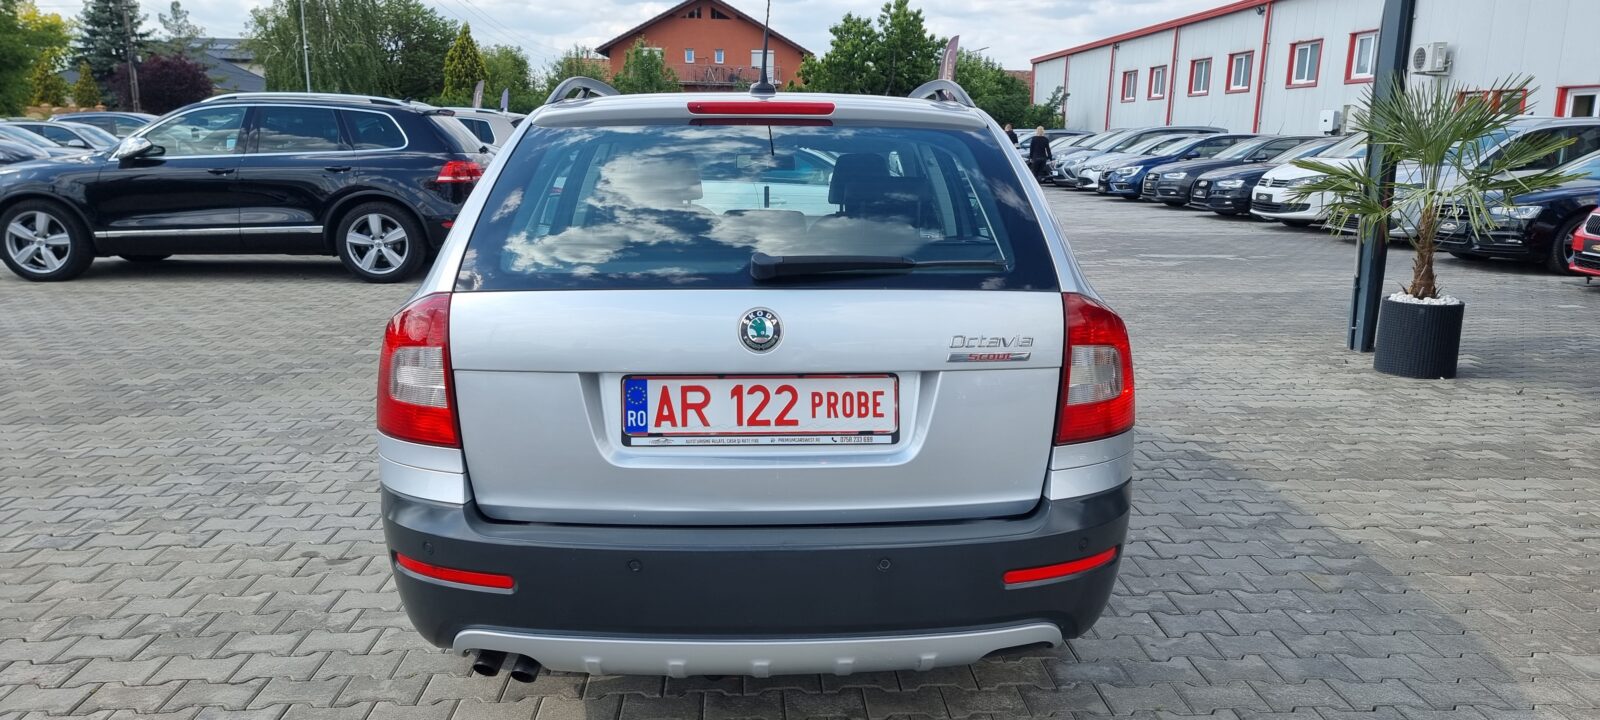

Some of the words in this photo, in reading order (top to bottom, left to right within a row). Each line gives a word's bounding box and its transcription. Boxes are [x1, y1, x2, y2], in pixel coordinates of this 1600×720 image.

[949, 333, 1034, 349] Octavia
[653, 384, 711, 428] AR
[730, 384, 799, 427] 122
[811, 391, 885, 418] PROBE
[627, 410, 647, 427] RO
